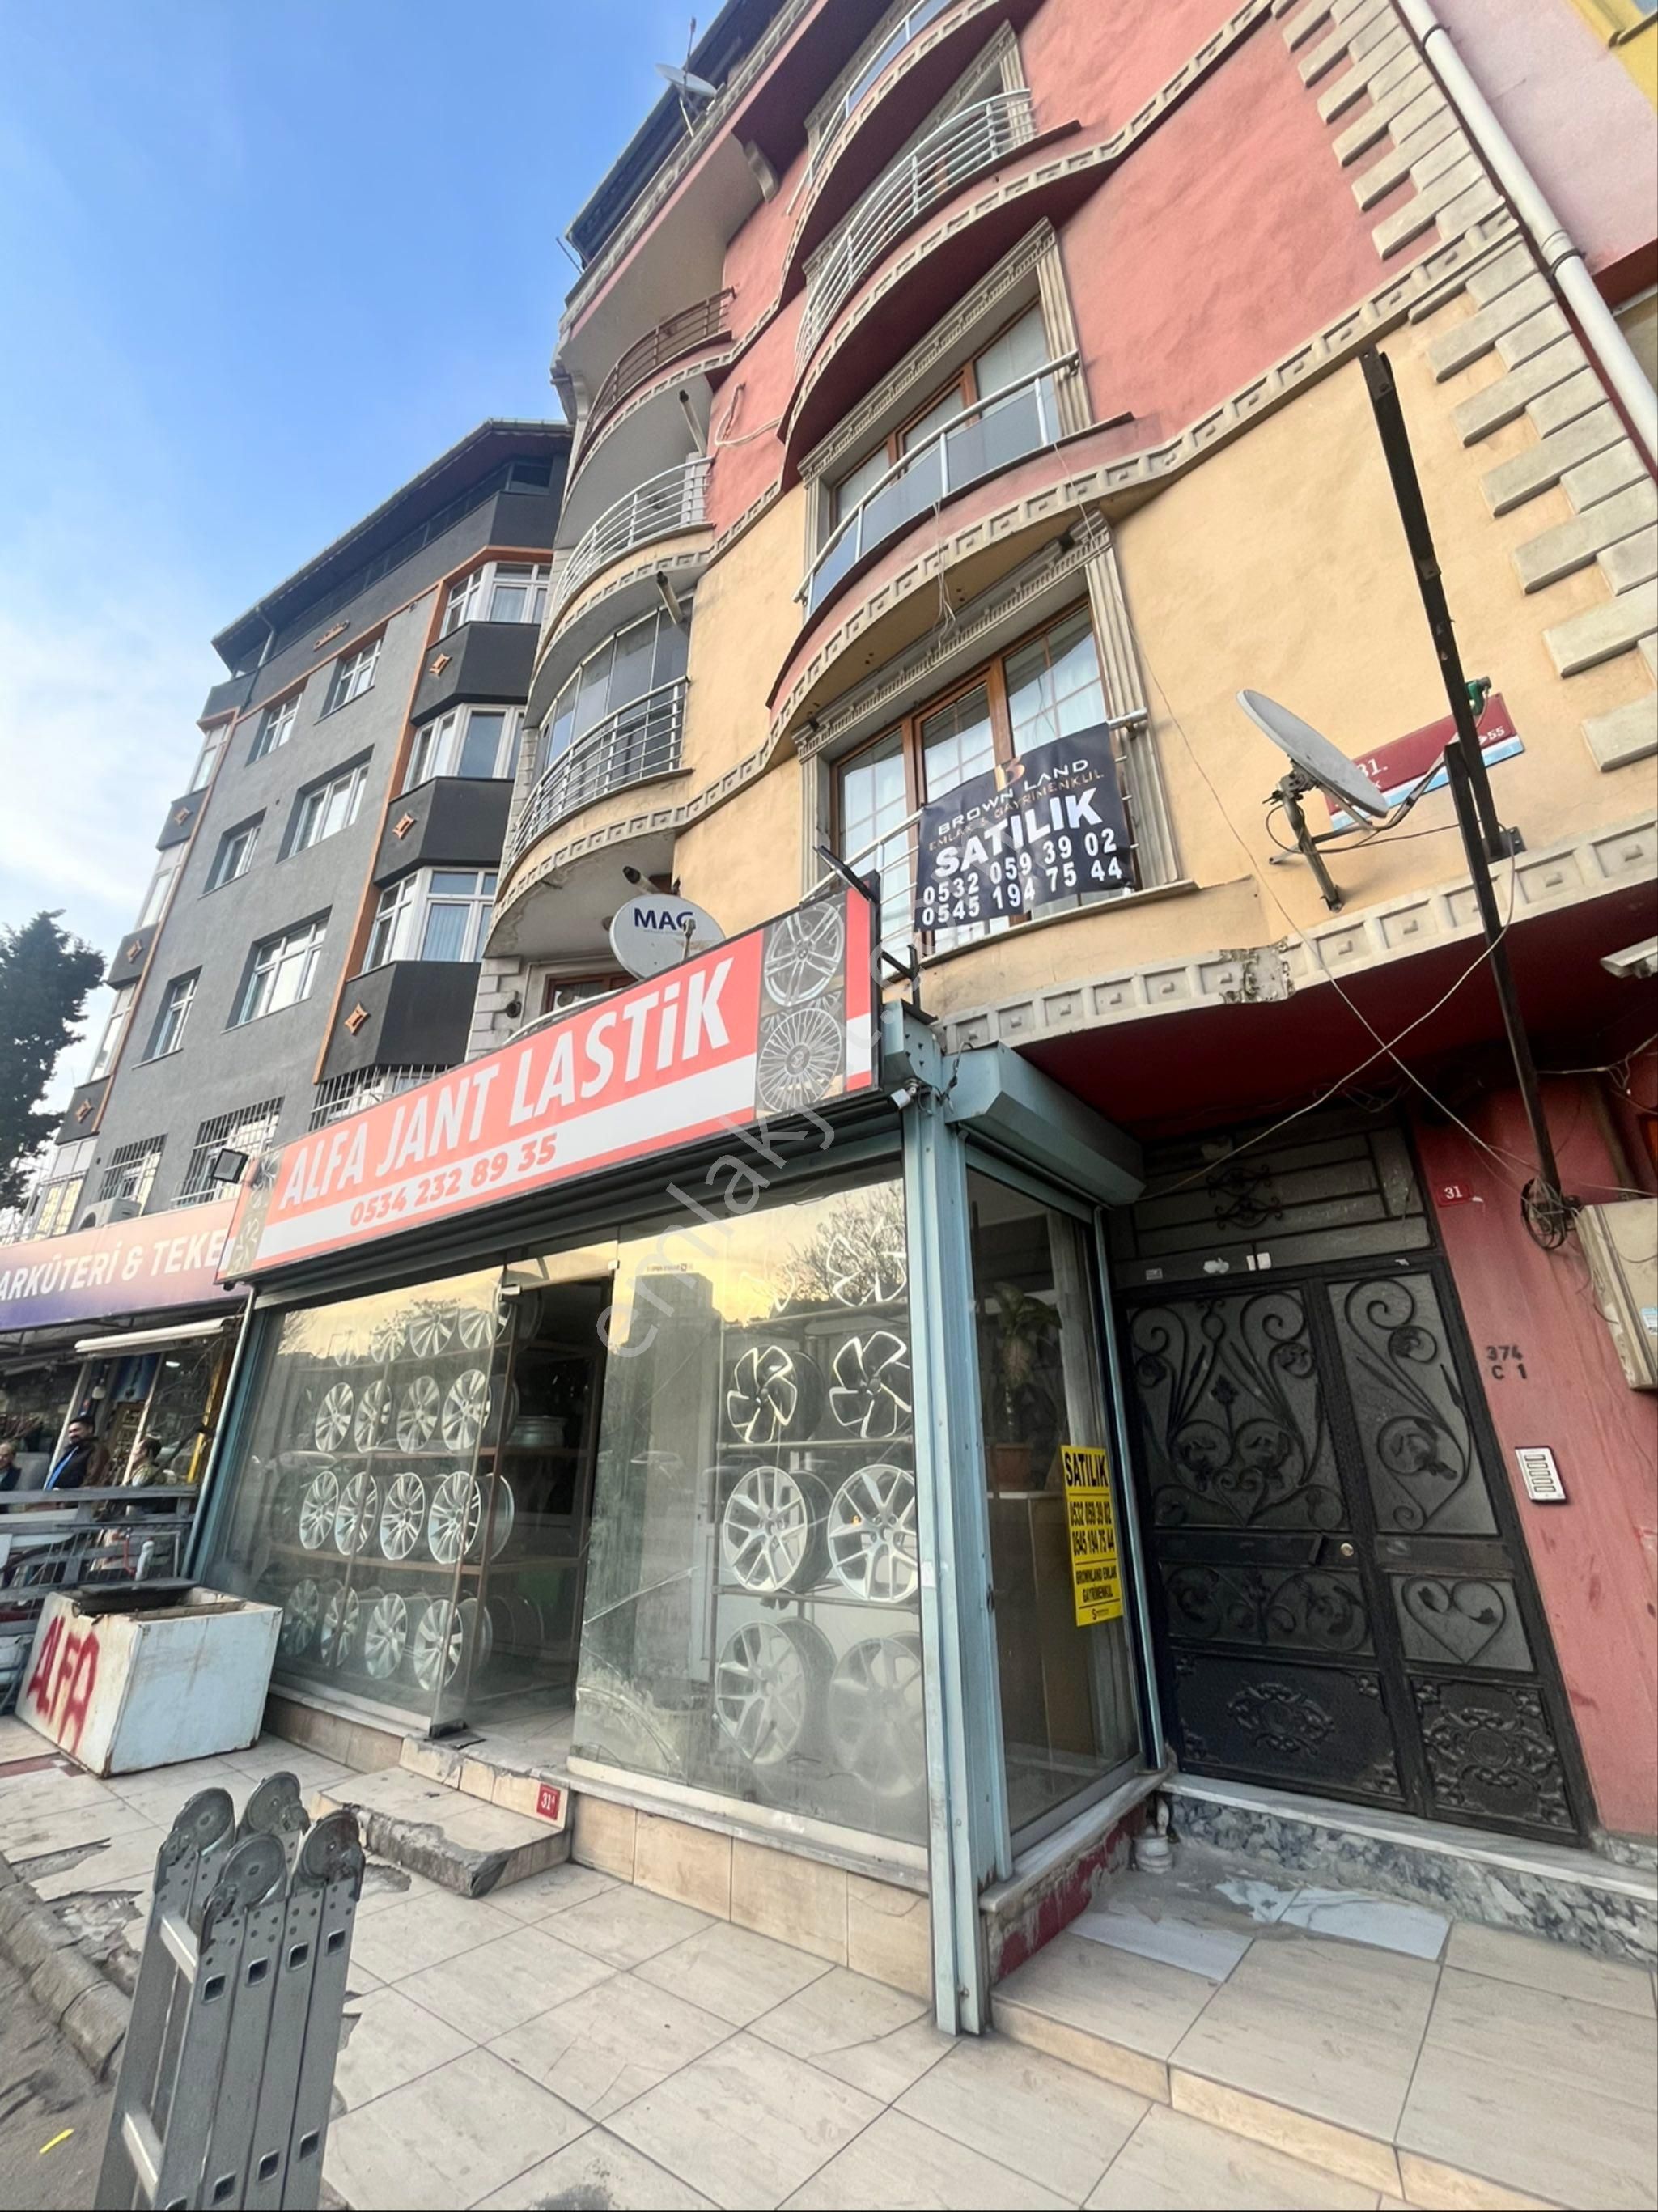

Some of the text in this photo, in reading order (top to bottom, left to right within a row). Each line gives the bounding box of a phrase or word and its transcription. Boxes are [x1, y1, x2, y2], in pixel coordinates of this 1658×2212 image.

[935, 788, 1103, 878] SATILIK
[938, 759, 1089, 836] BROWN LAND
[922, 827, 1117, 906] 0532 059 39 02
[928, 824, 973, 851] EMLAK
[921, 856, 1123, 927] 0545 194 75 44
[279, 1121, 369, 1211] ALFA
[375, 1062, 502, 1178] JANT
[350, 1132, 558, 1228] 0534 232 89 35
[1444, 1185, 1463, 1199] 31
[121, 1246, 143, 1281] &
[1491, 1363, 1527, 1380] C 1
[1064, 1452, 1109, 1487] SATILIK
